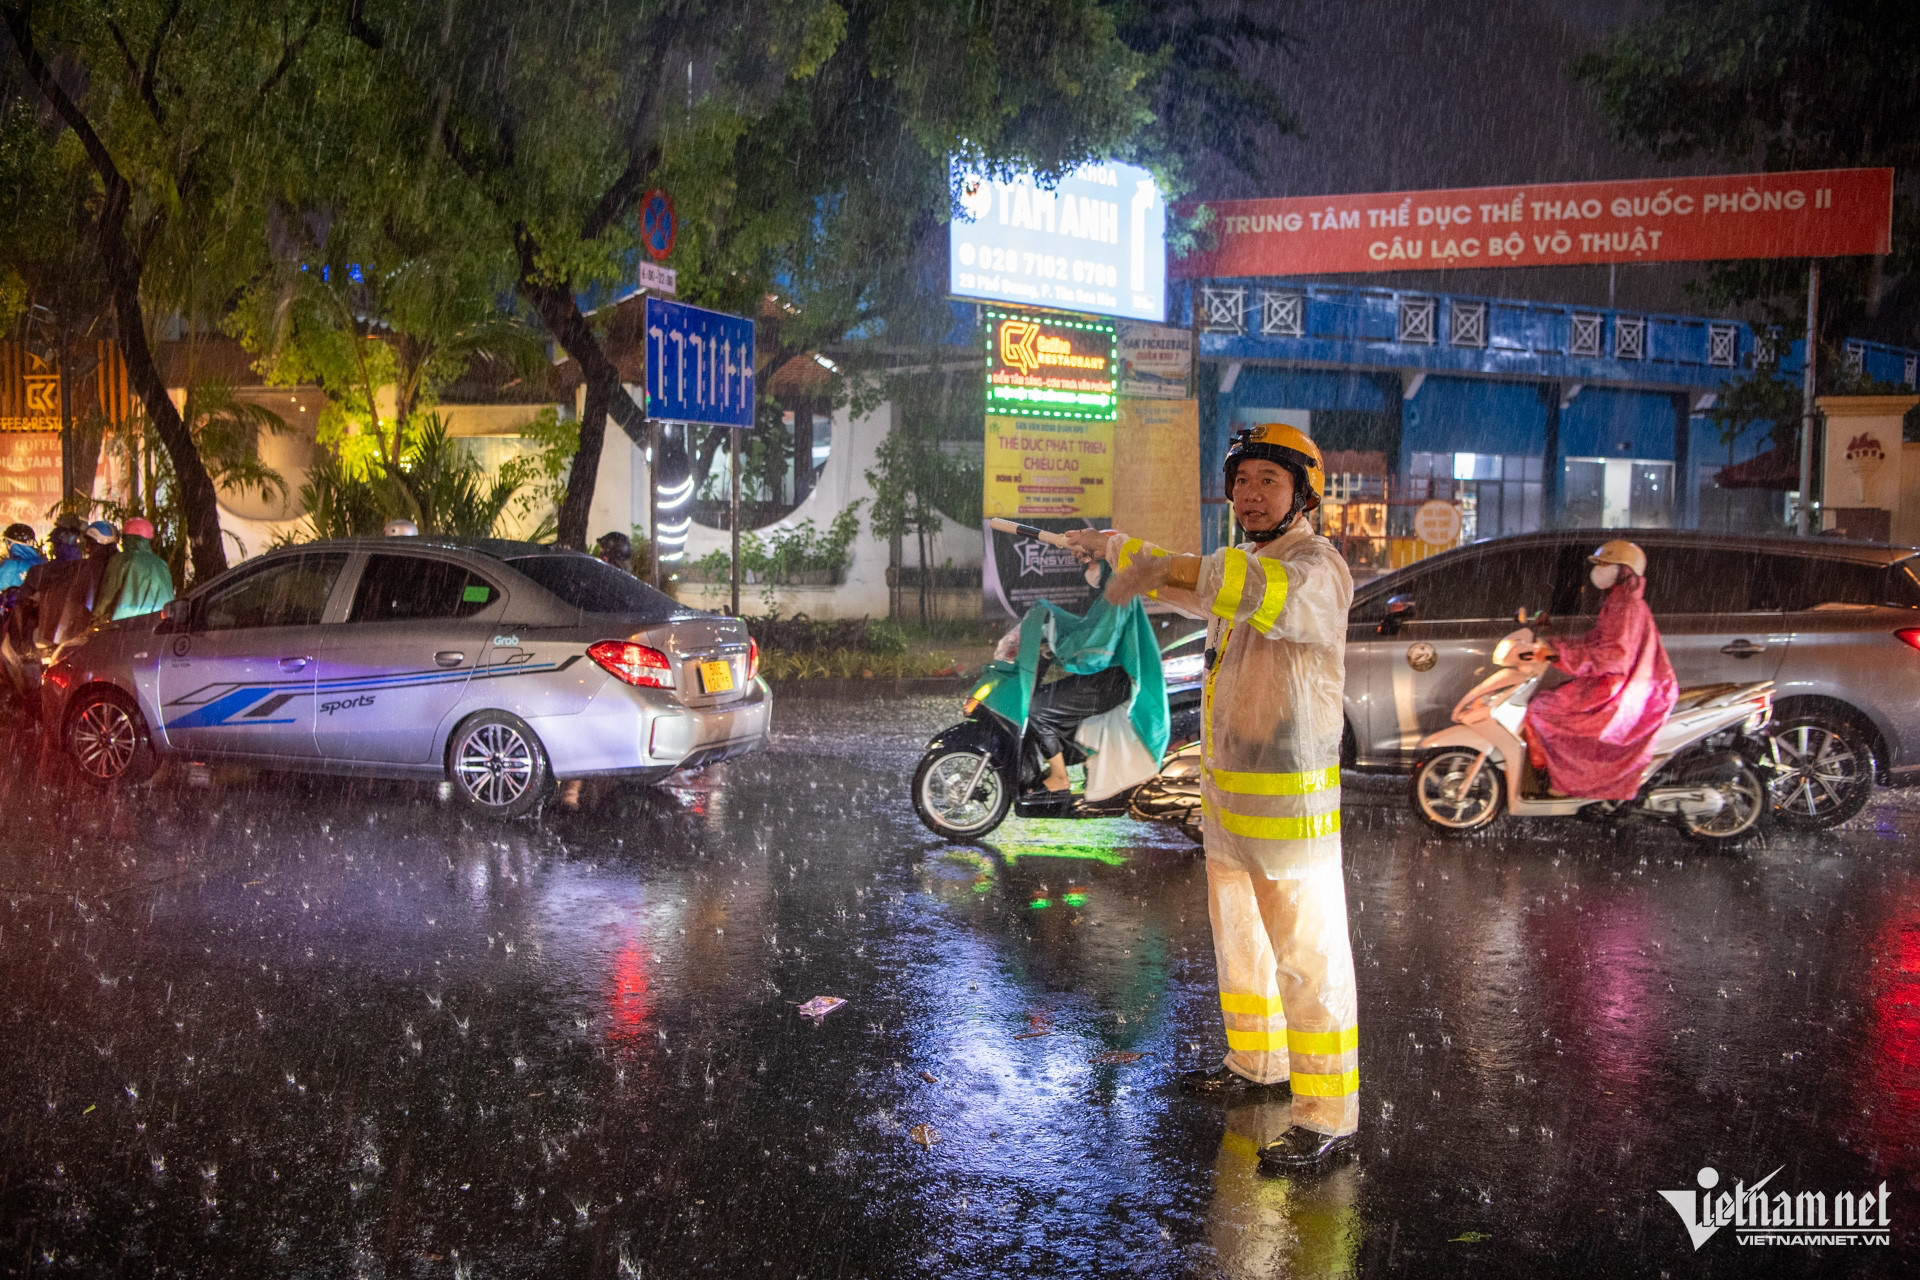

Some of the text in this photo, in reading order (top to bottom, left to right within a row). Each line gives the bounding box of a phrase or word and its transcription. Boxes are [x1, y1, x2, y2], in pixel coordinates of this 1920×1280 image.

[993, 173, 1118, 244] TÂM ANH
[1225, 187, 1832, 235] TRUNG TÂM THỂ DỤC THỂ THAO QUỐC PHÒNG II
[1368, 226, 1663, 264] CÂU LẠC BỘ VÕ THUẬT
[1022, 252, 1068, 281] 7102
[1037, 352, 1105, 370] RESTAURANT
[1056, 458, 1079, 472] CAO
[1025, 544, 1083, 566] FANSVIE
[494, 635, 520, 646] Grab
[320, 695, 376, 715] sports
